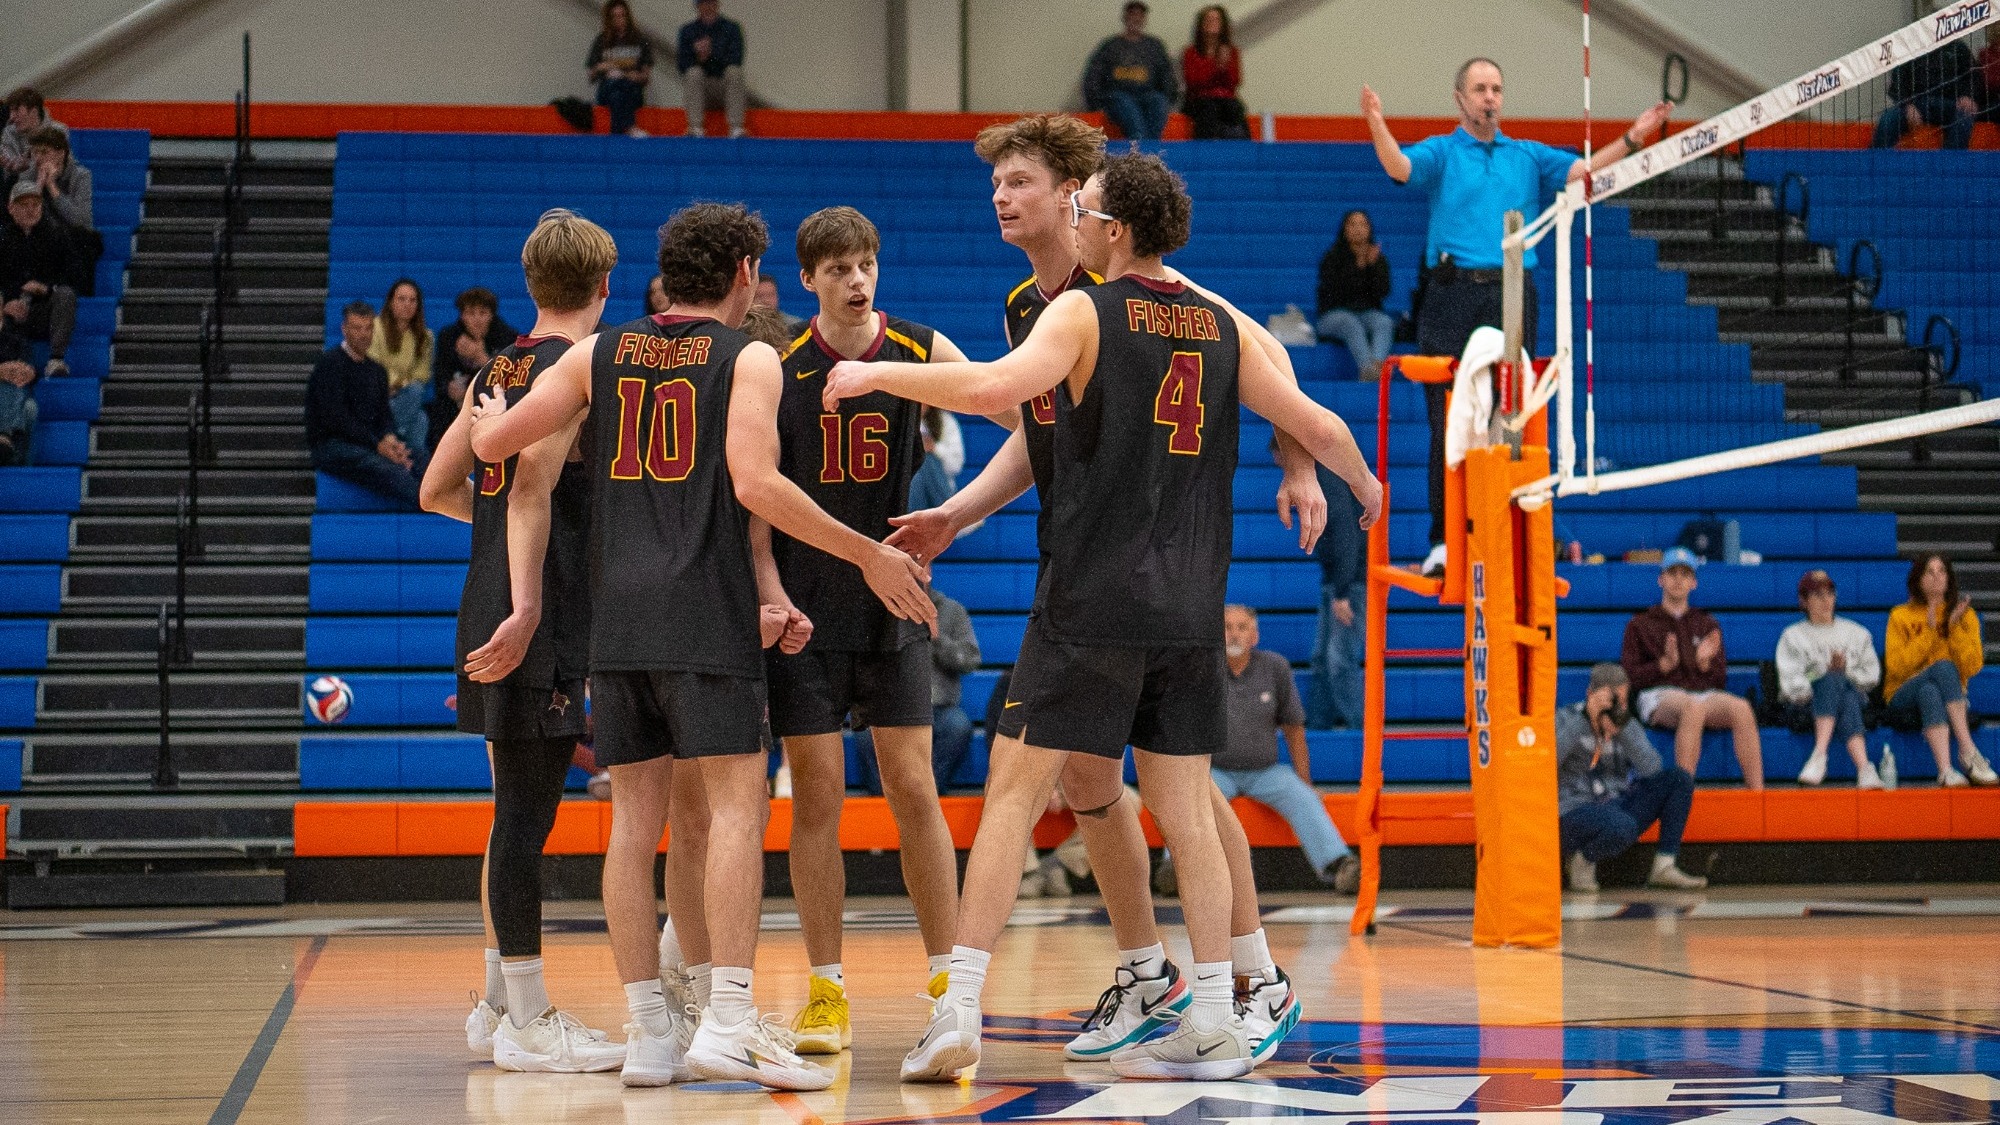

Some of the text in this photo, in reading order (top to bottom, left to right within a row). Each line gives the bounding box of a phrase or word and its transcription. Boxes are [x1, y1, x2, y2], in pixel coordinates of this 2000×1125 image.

[615, 333, 712, 369] FISHER
[1125, 299, 1221, 342] FISHER
[610, 378, 696, 482] 10
[1154, 351, 1204, 456] 4
[820, 413, 889, 483] 16
[1472, 561, 1491, 768] HAWKS
